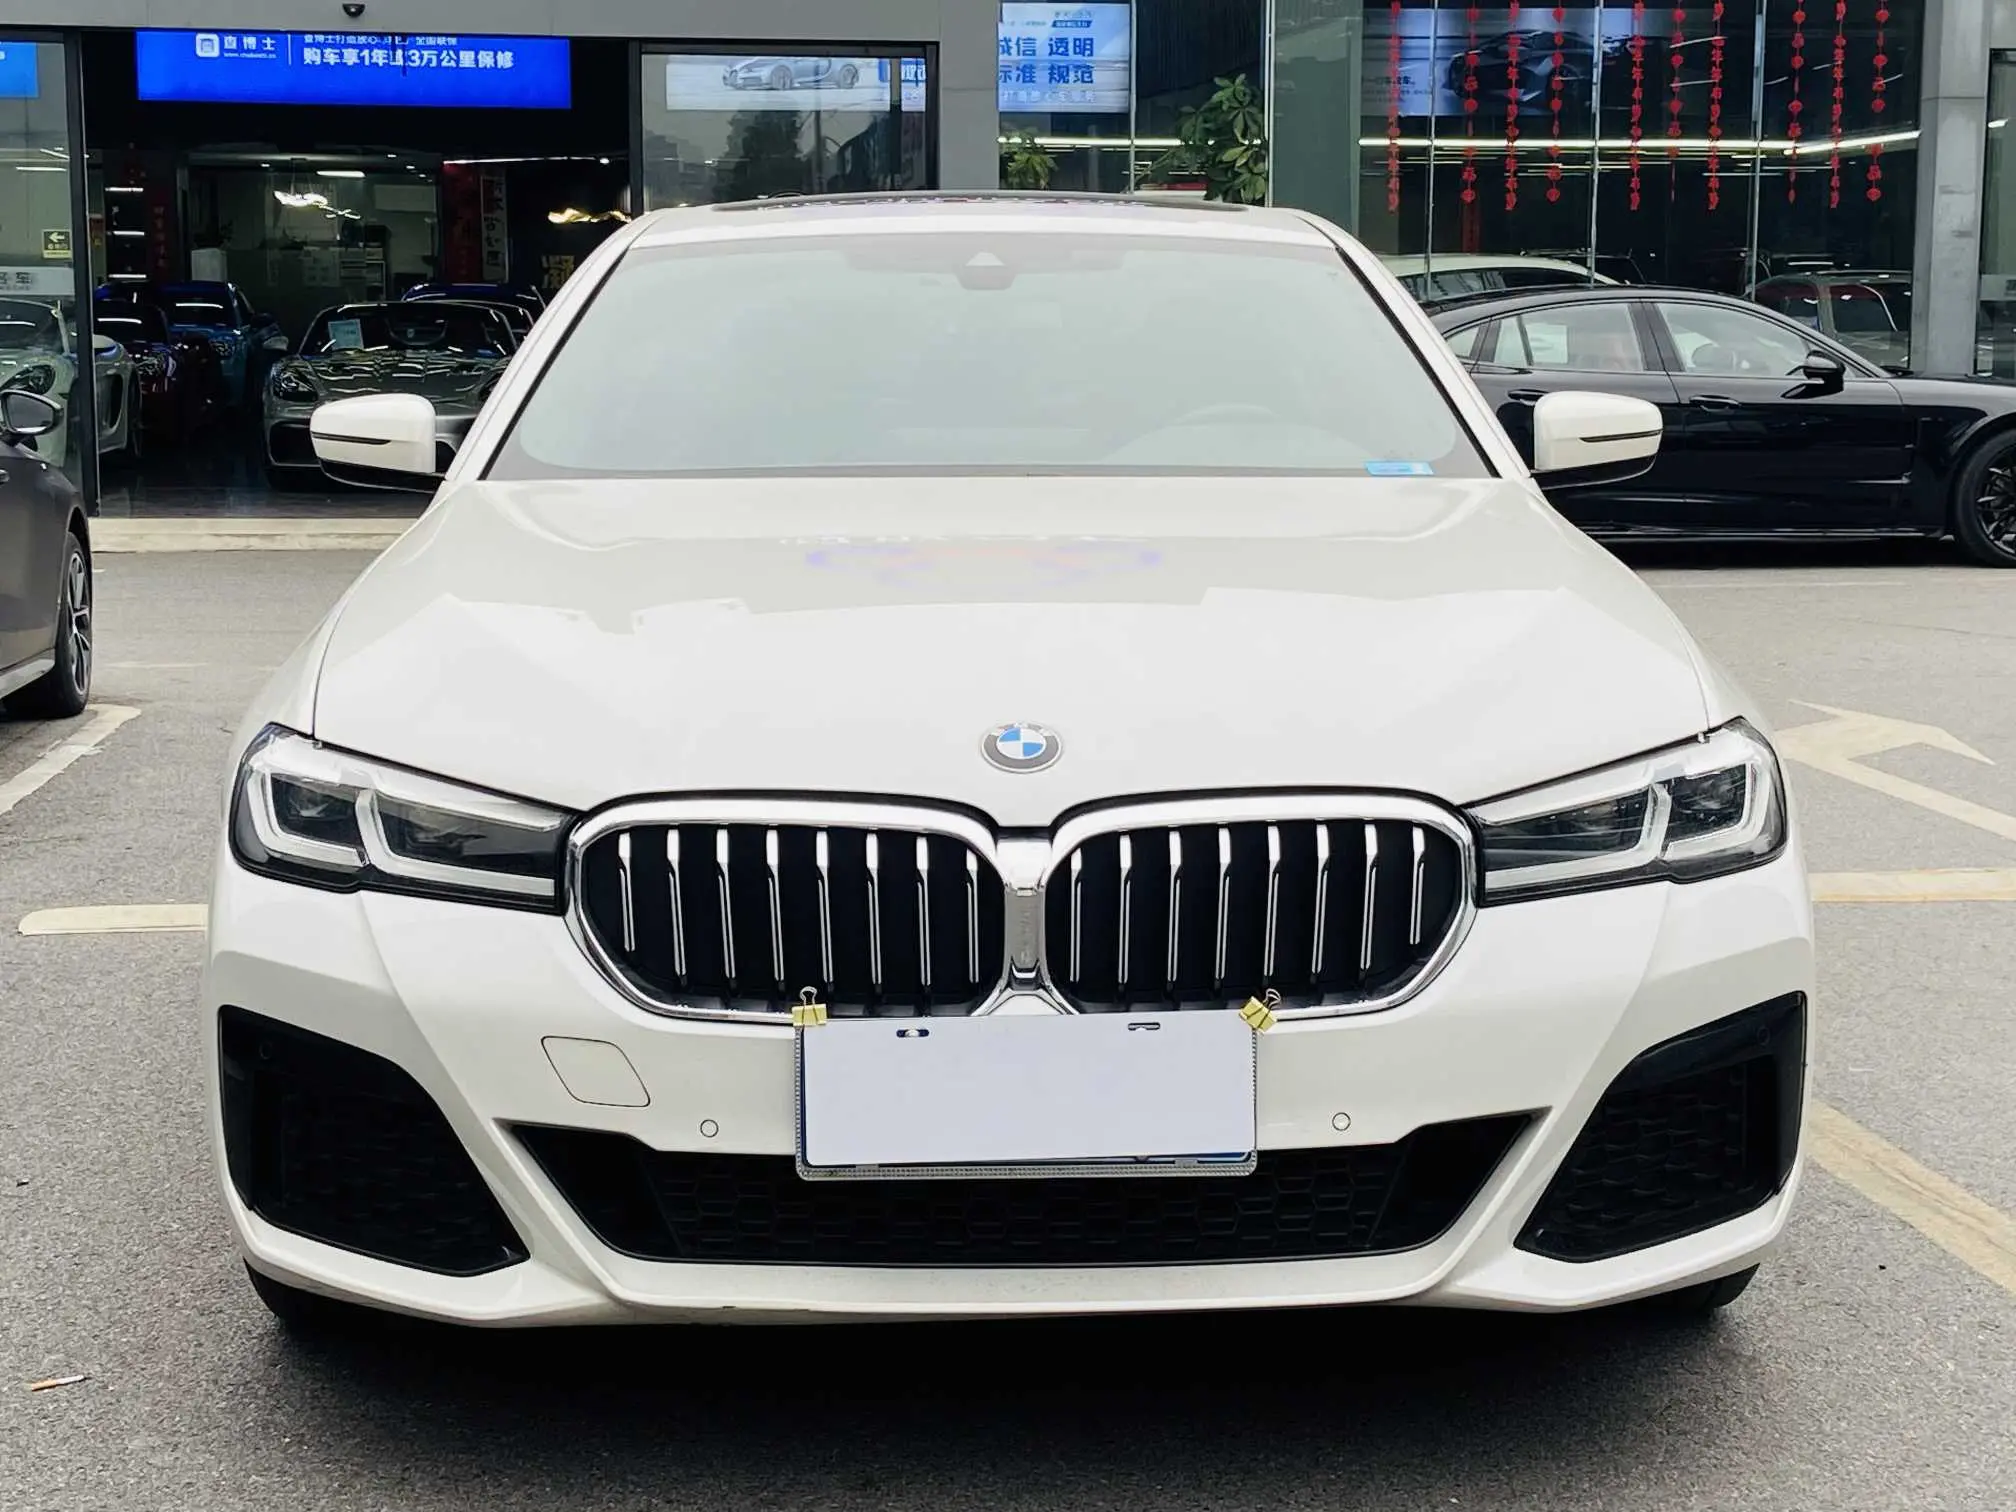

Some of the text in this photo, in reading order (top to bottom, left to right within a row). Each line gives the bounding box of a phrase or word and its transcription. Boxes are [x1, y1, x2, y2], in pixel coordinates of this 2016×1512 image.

[223, 36, 276, 51] 查博士
[1048, 37, 1094, 57] 透明
[1048, 64, 1095, 84] 规范
